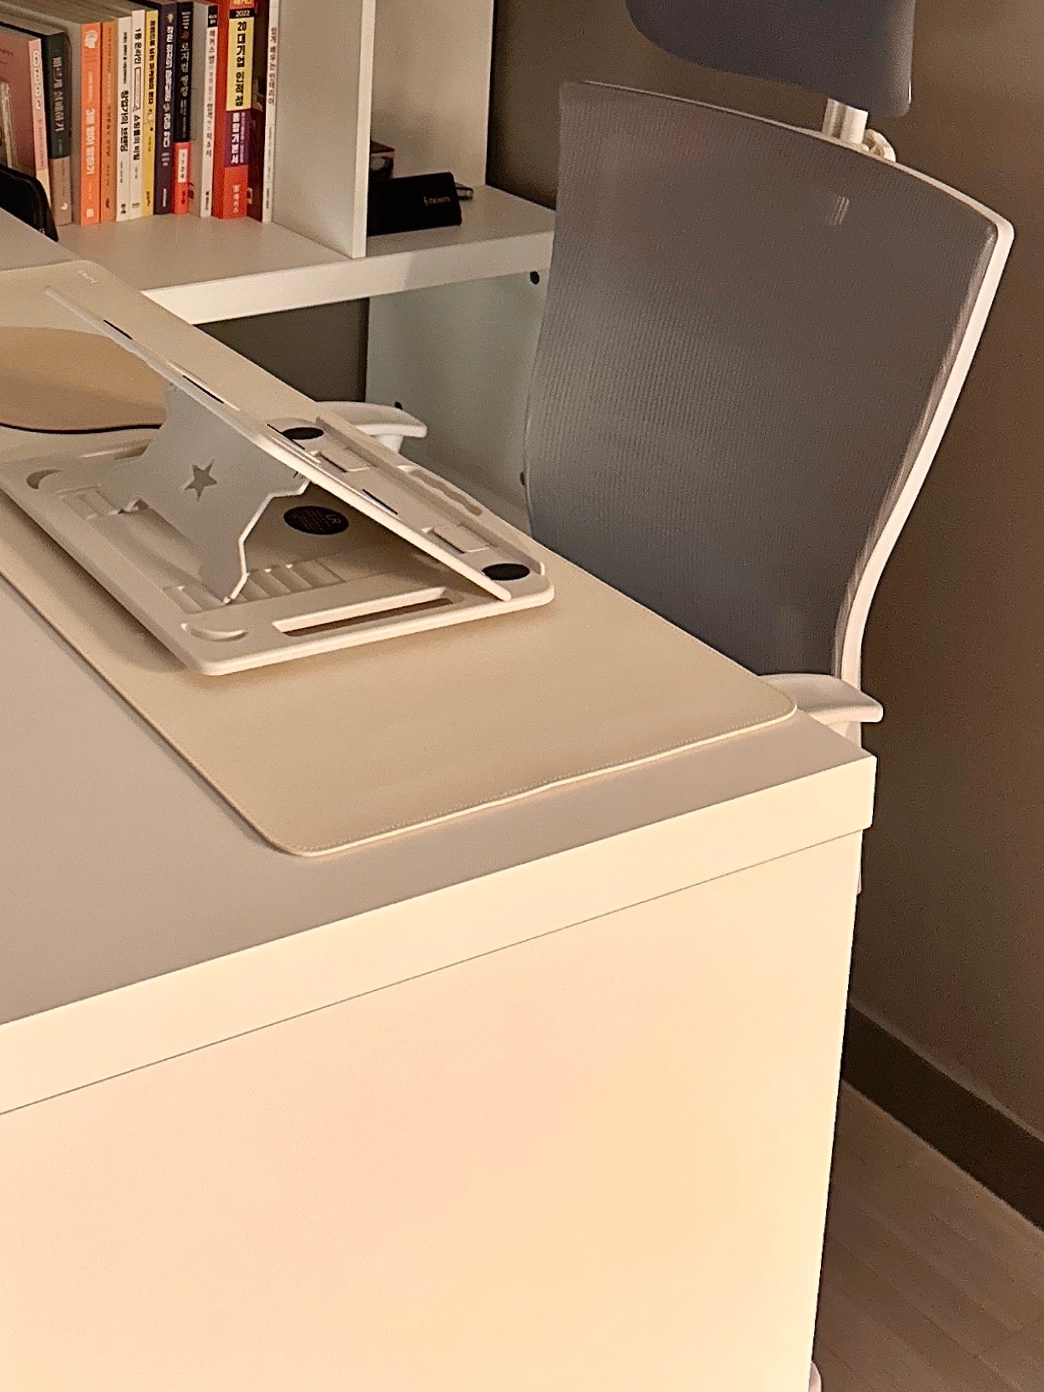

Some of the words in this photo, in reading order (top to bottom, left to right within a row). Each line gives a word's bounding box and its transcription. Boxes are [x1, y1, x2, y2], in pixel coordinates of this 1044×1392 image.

[235, 10, 251, 18] 2022
[134, 42, 142, 64] 온라인
[120, 90, 130, 124] 창업가의
[120, 127, 129, 153] 브랜딩
[132, 114, 141, 144] 쇼핑몰의
[132, 146, 141, 161] 비밀
